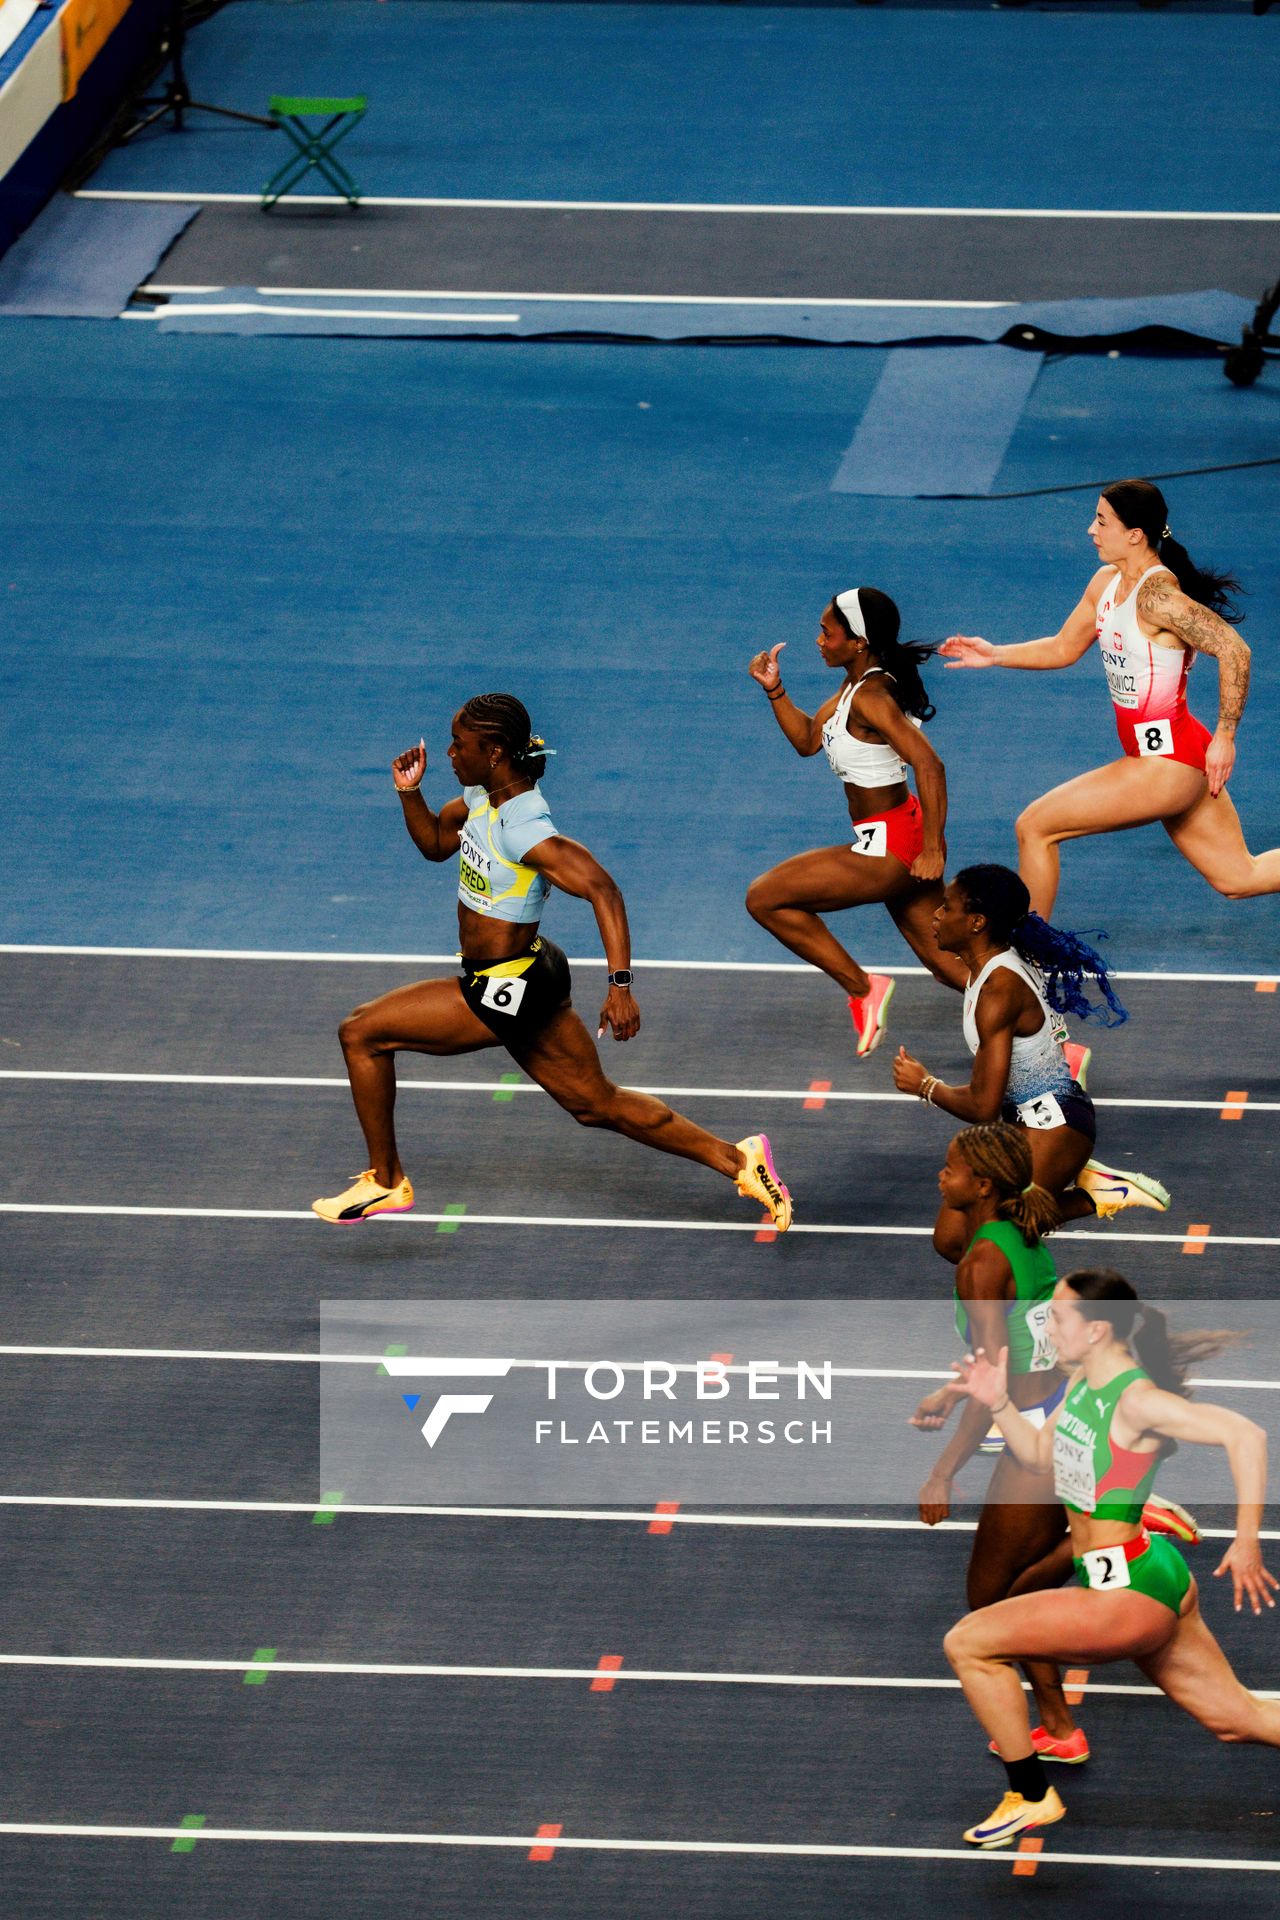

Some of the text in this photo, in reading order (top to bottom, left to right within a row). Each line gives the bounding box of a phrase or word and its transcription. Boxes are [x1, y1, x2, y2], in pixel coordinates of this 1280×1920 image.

[1100, 649, 1127, 669] ONY
[1144, 727, 1164, 751] 8
[861, 827, 877, 851] 7
[460, 840, 485, 870] ONY
[460, 860, 487, 892] FRED
[492, 980, 515, 1008] 6
[1055, 1437, 1085, 1463] ONY
[1096, 1555, 1117, 1584] 2
